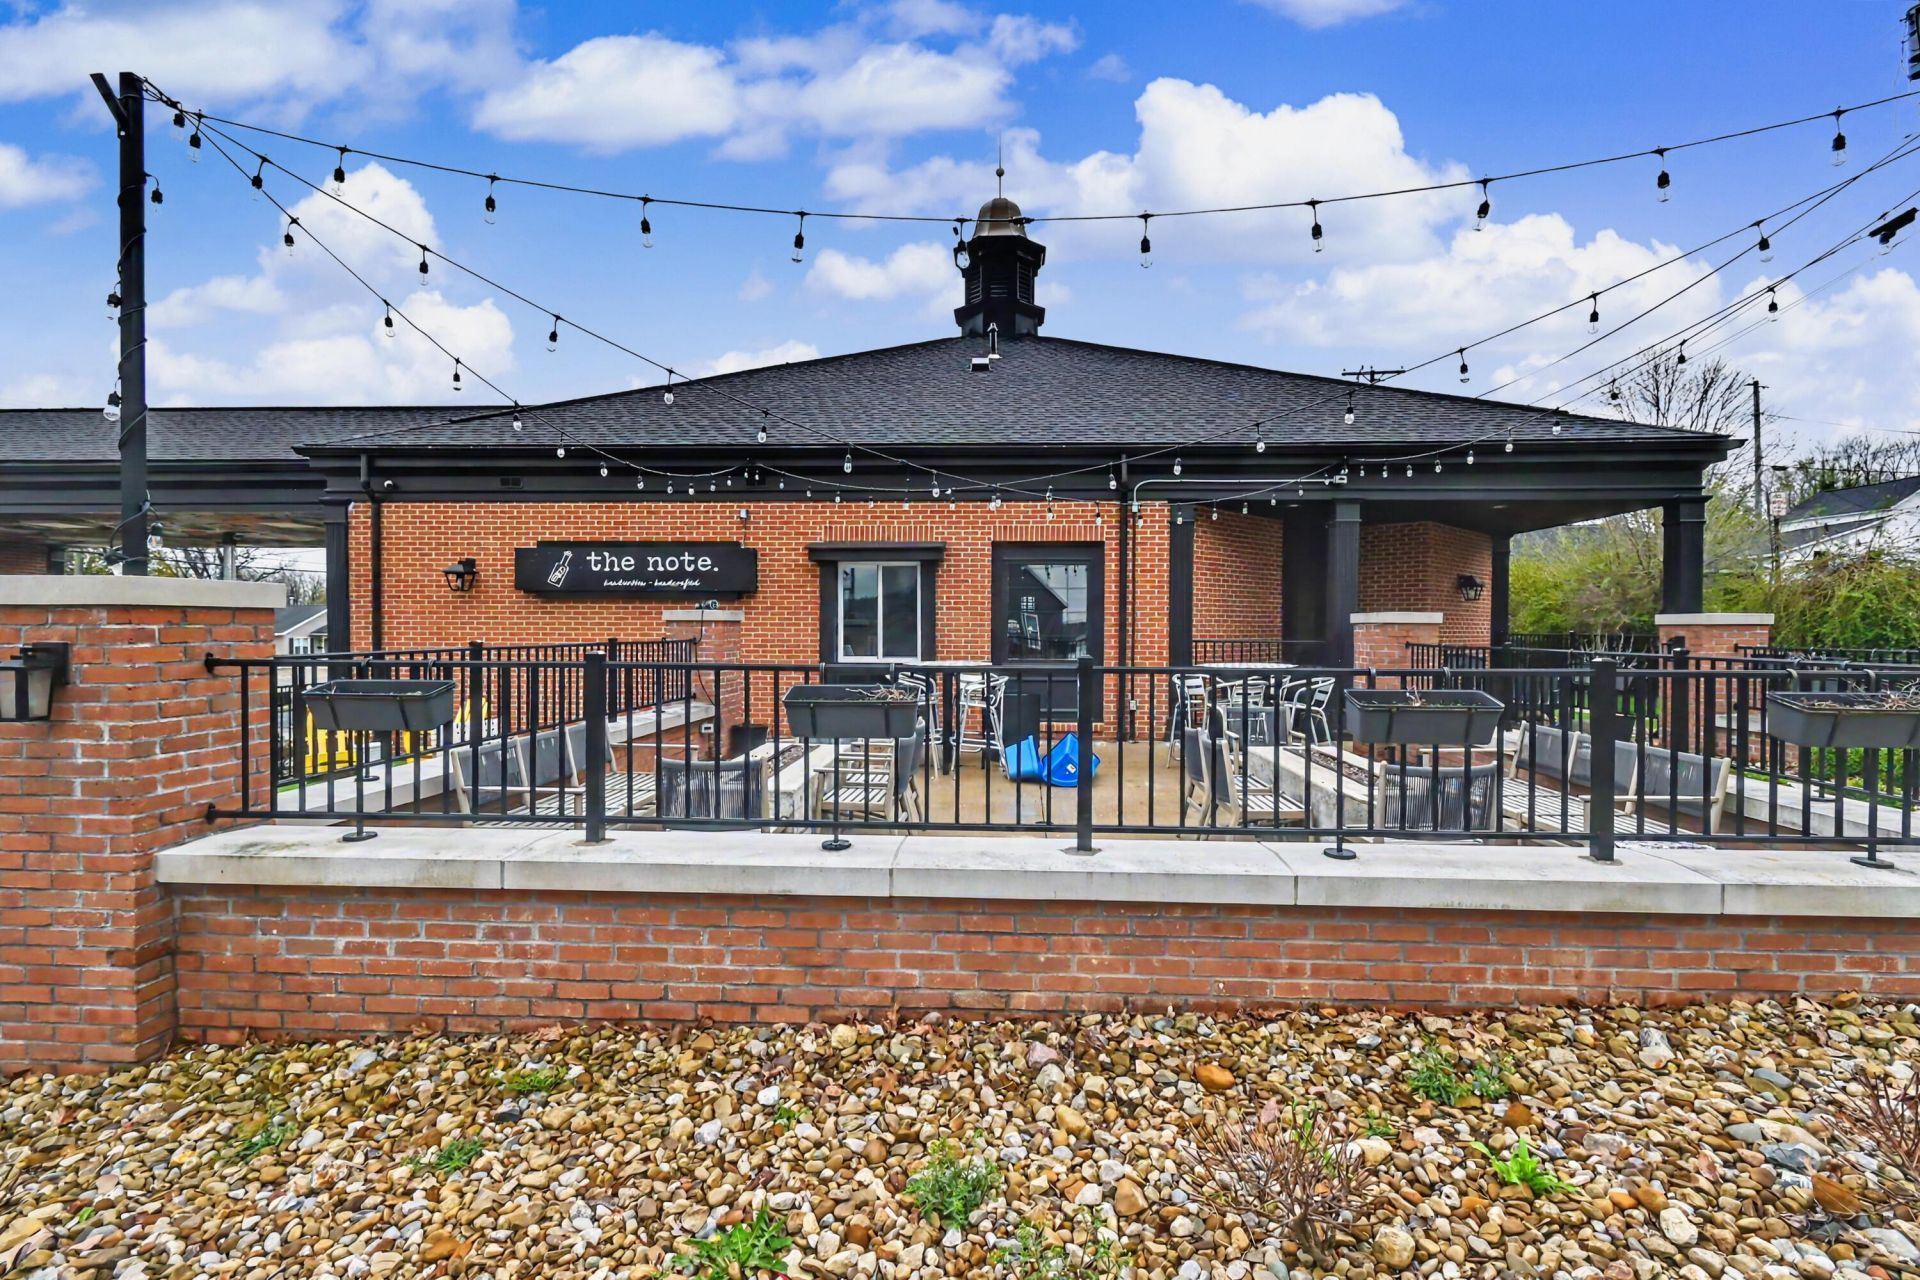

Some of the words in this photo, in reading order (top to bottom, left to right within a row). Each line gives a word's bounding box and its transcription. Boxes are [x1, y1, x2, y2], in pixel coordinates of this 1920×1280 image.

[586, 551, 635, 572] the
[647, 551, 719, 572] note.
[654, 578, 700, 590] handcrafted
